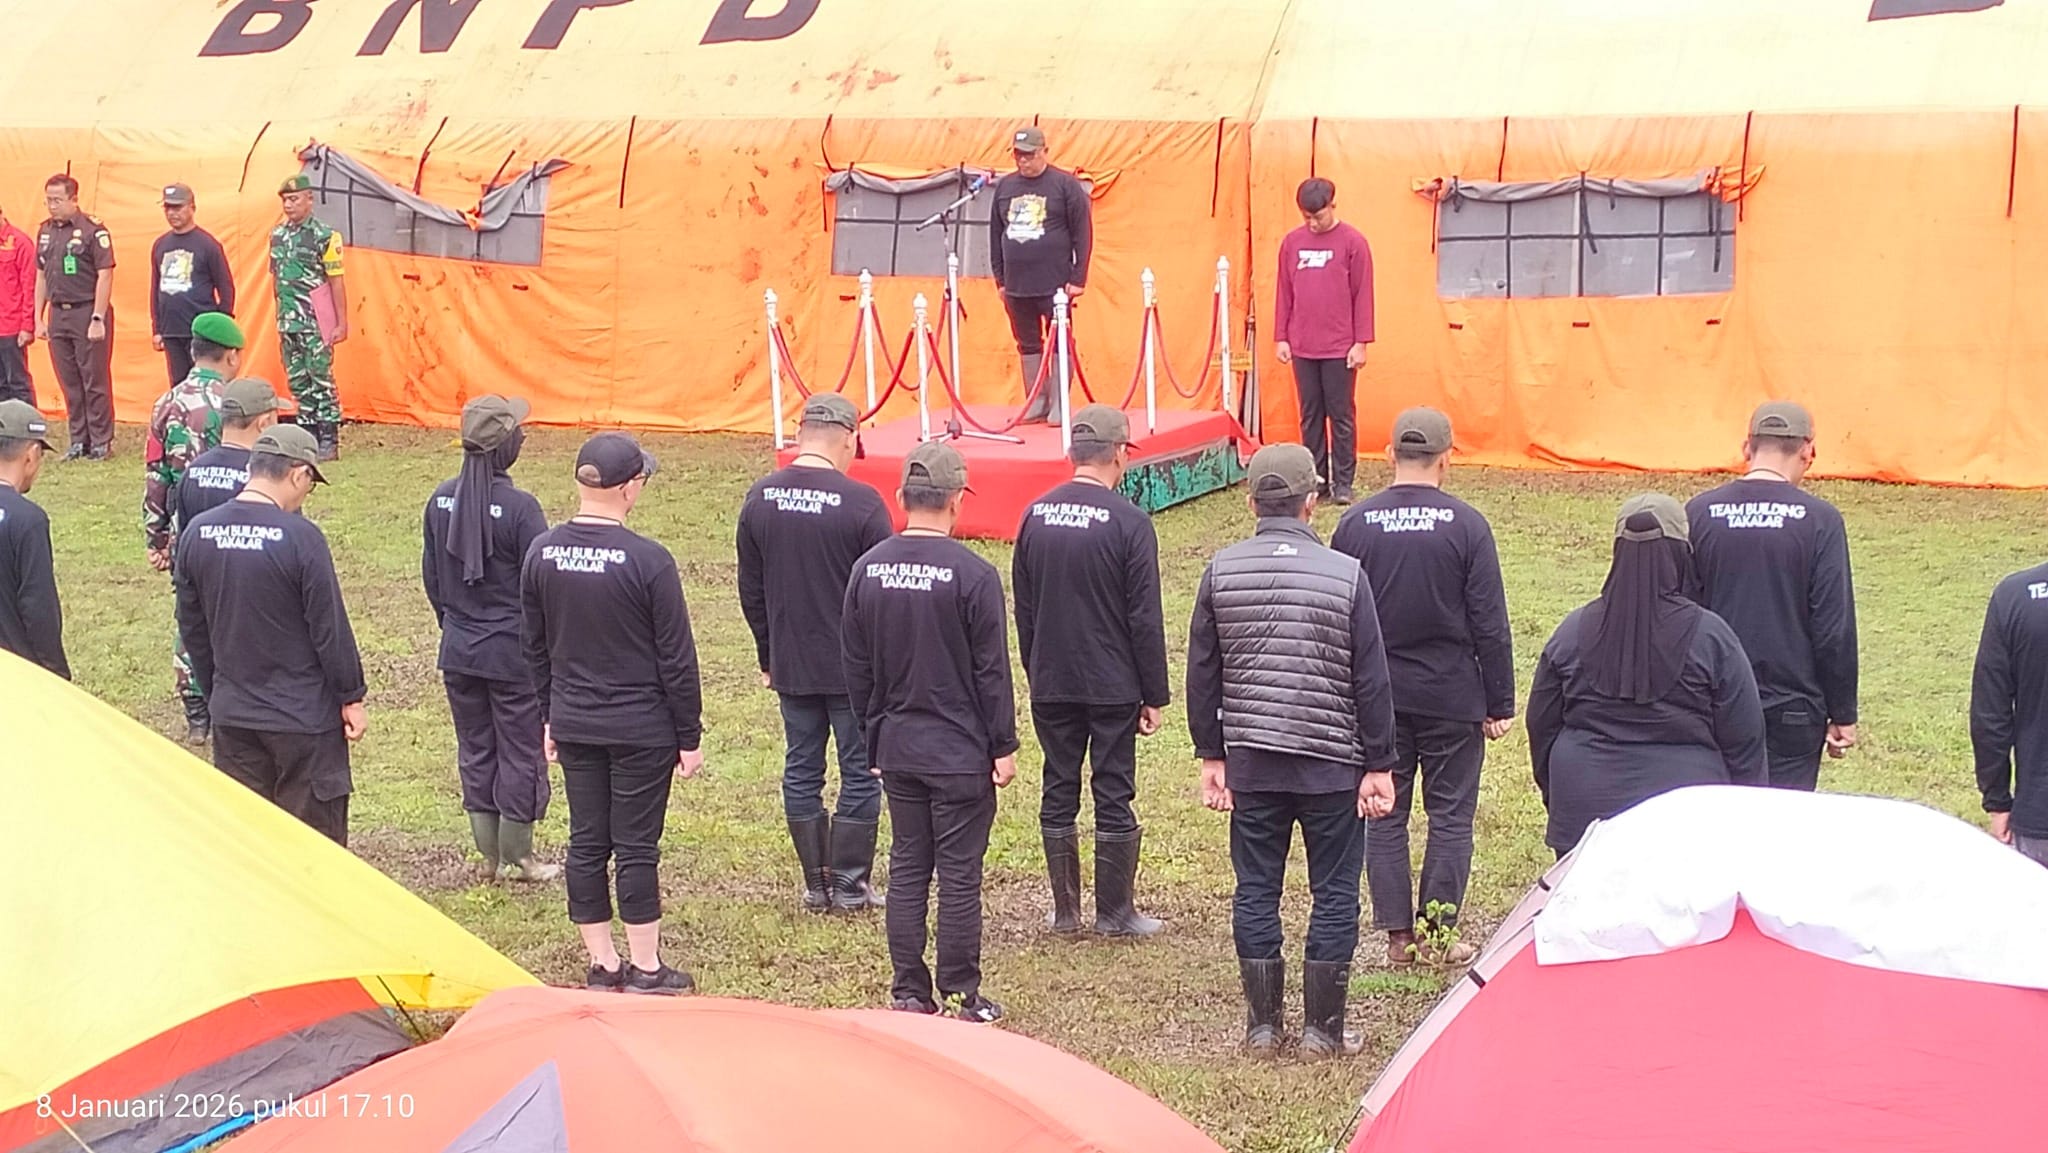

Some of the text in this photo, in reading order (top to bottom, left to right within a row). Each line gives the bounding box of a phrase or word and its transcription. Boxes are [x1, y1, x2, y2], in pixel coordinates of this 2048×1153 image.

[189, 466, 249, 483] TEAM BUILDING
[198, 476, 234, 490] TAKALAR
[763, 487, 841, 506] TEAM BUILDING
[776, 498, 822, 514] TAKALAR
[1032, 503, 1109, 522] TEAM BUILDING
[1709, 502, 1806, 519] TEAM BUILDING
[1044, 513, 1089, 528] TAKALAR
[1364, 507, 1454, 524] TEAM BUILDING
[1727, 514, 1784, 528] TAKALAR
[200, 525, 283, 541] TEAM BUILDING
[1381, 519, 1435, 532] TAKALAR
[214, 535, 263, 550] TAKALAR
[542, 546, 626, 564] TEAM BUILDING
[555, 557, 605, 573] TAKALAR
[866, 563, 953, 582] TEAM BUILDING
[880, 574, 932, 591] TAKALAR
